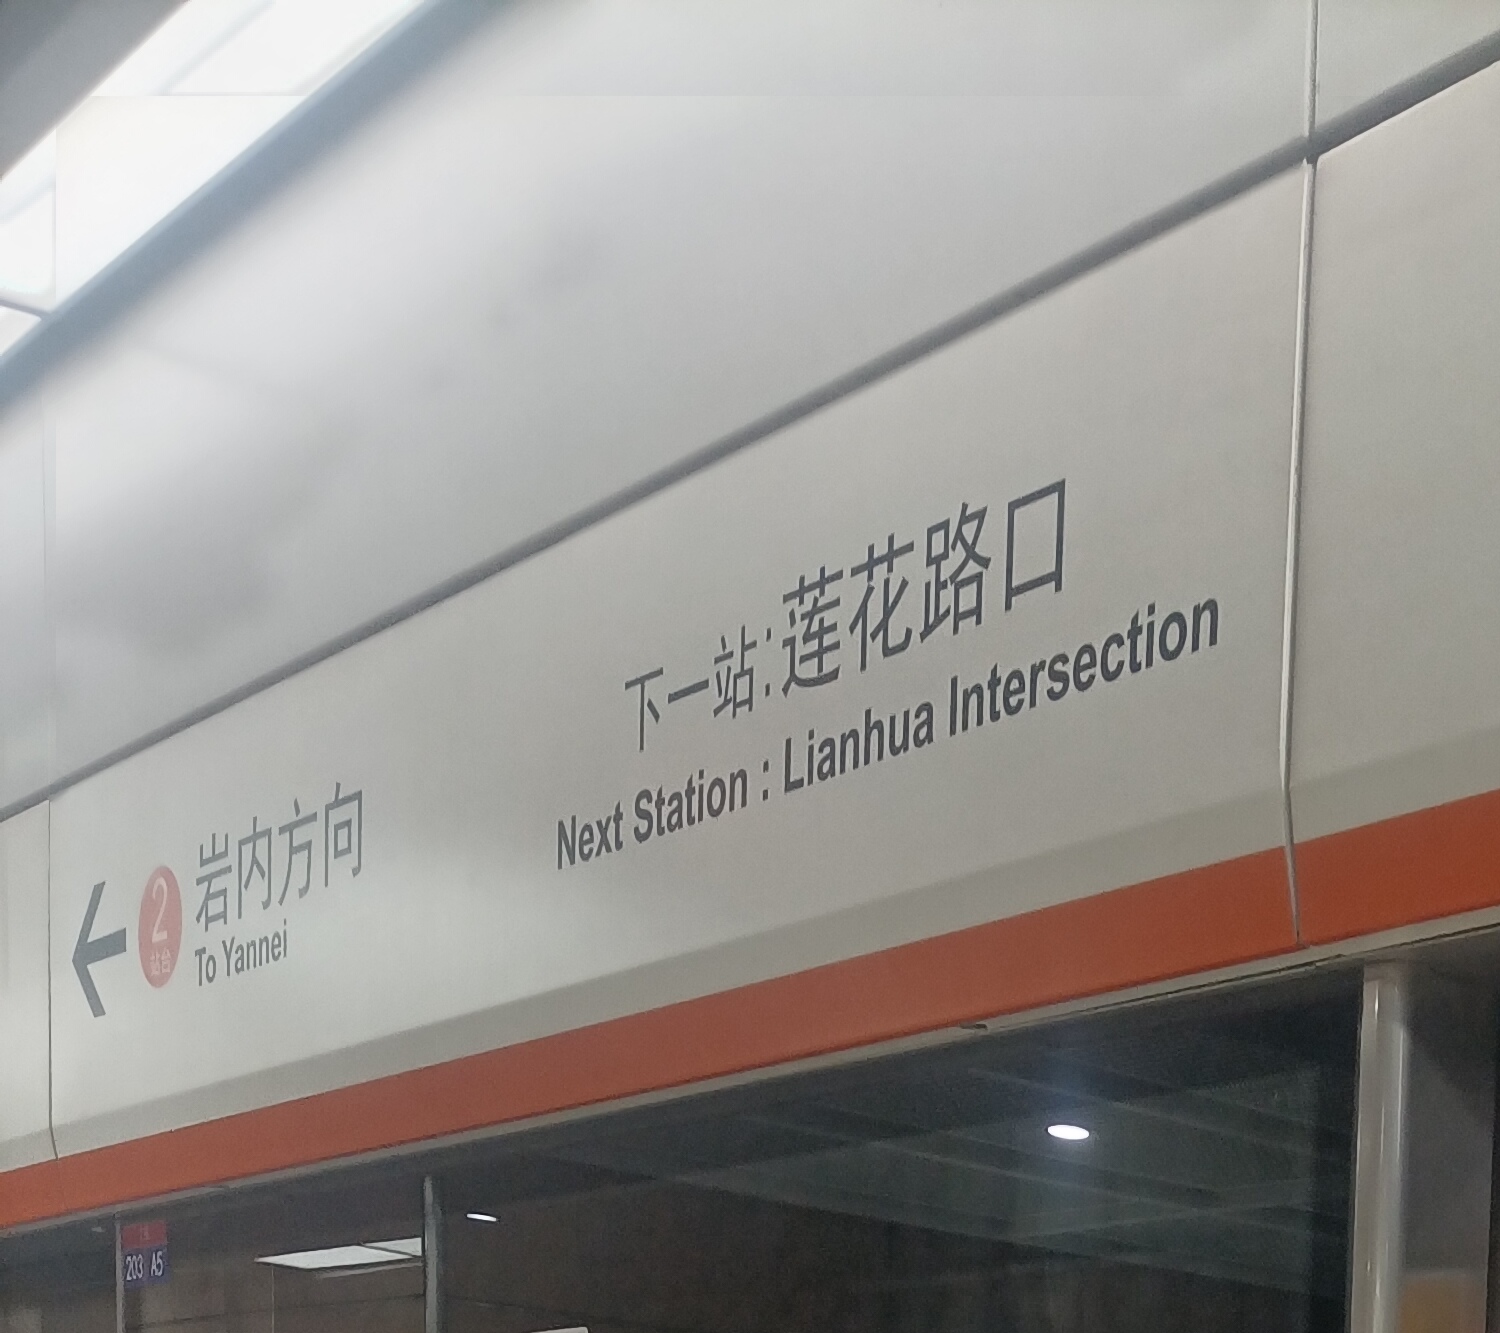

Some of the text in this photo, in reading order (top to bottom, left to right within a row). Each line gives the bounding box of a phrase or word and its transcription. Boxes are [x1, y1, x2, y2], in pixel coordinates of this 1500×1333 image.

[557, 800, 624, 870] Next
[633, 767, 748, 844] Station
[784, 701, 934, 793] Lianhua
[950, 597, 1218, 738] Intersection
[151, 877, 168, 943] 2
[195, 781, 363, 932] 岩内方向
[195, 918, 288, 986] To Yannei
